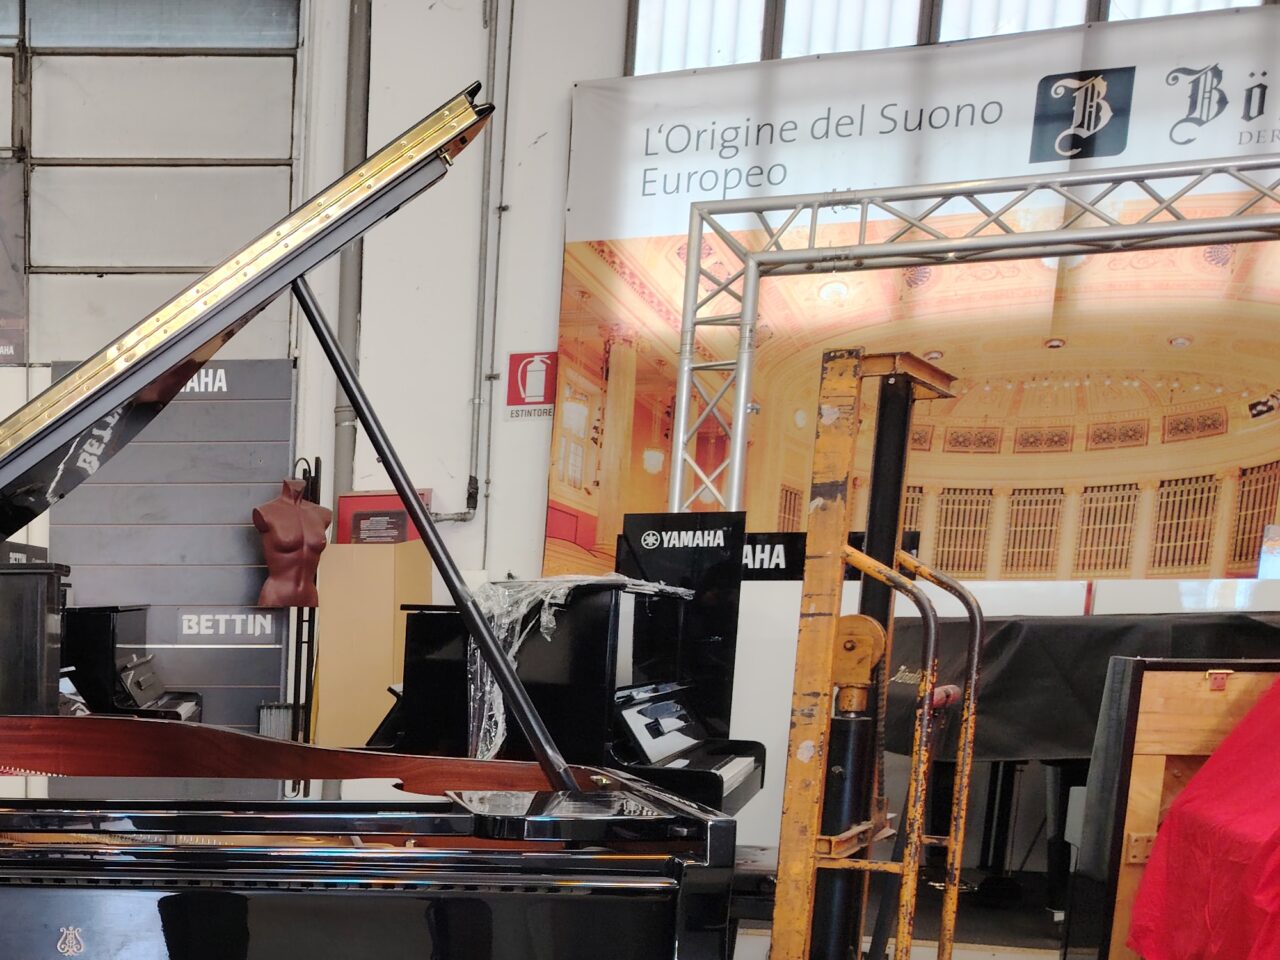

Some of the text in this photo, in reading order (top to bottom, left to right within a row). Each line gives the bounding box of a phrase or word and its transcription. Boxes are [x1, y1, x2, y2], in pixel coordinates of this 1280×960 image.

[810, 104, 865, 140] del
[879, 100, 1004, 135] Suono
[642, 163, 788, 199] Europeo
[180, 368, 227, 393] AHA
[510, 408, 553, 418] ESTINTORE
[662, 530, 725, 548] YAMAHA
[182, 614, 272, 636] BETTIN
